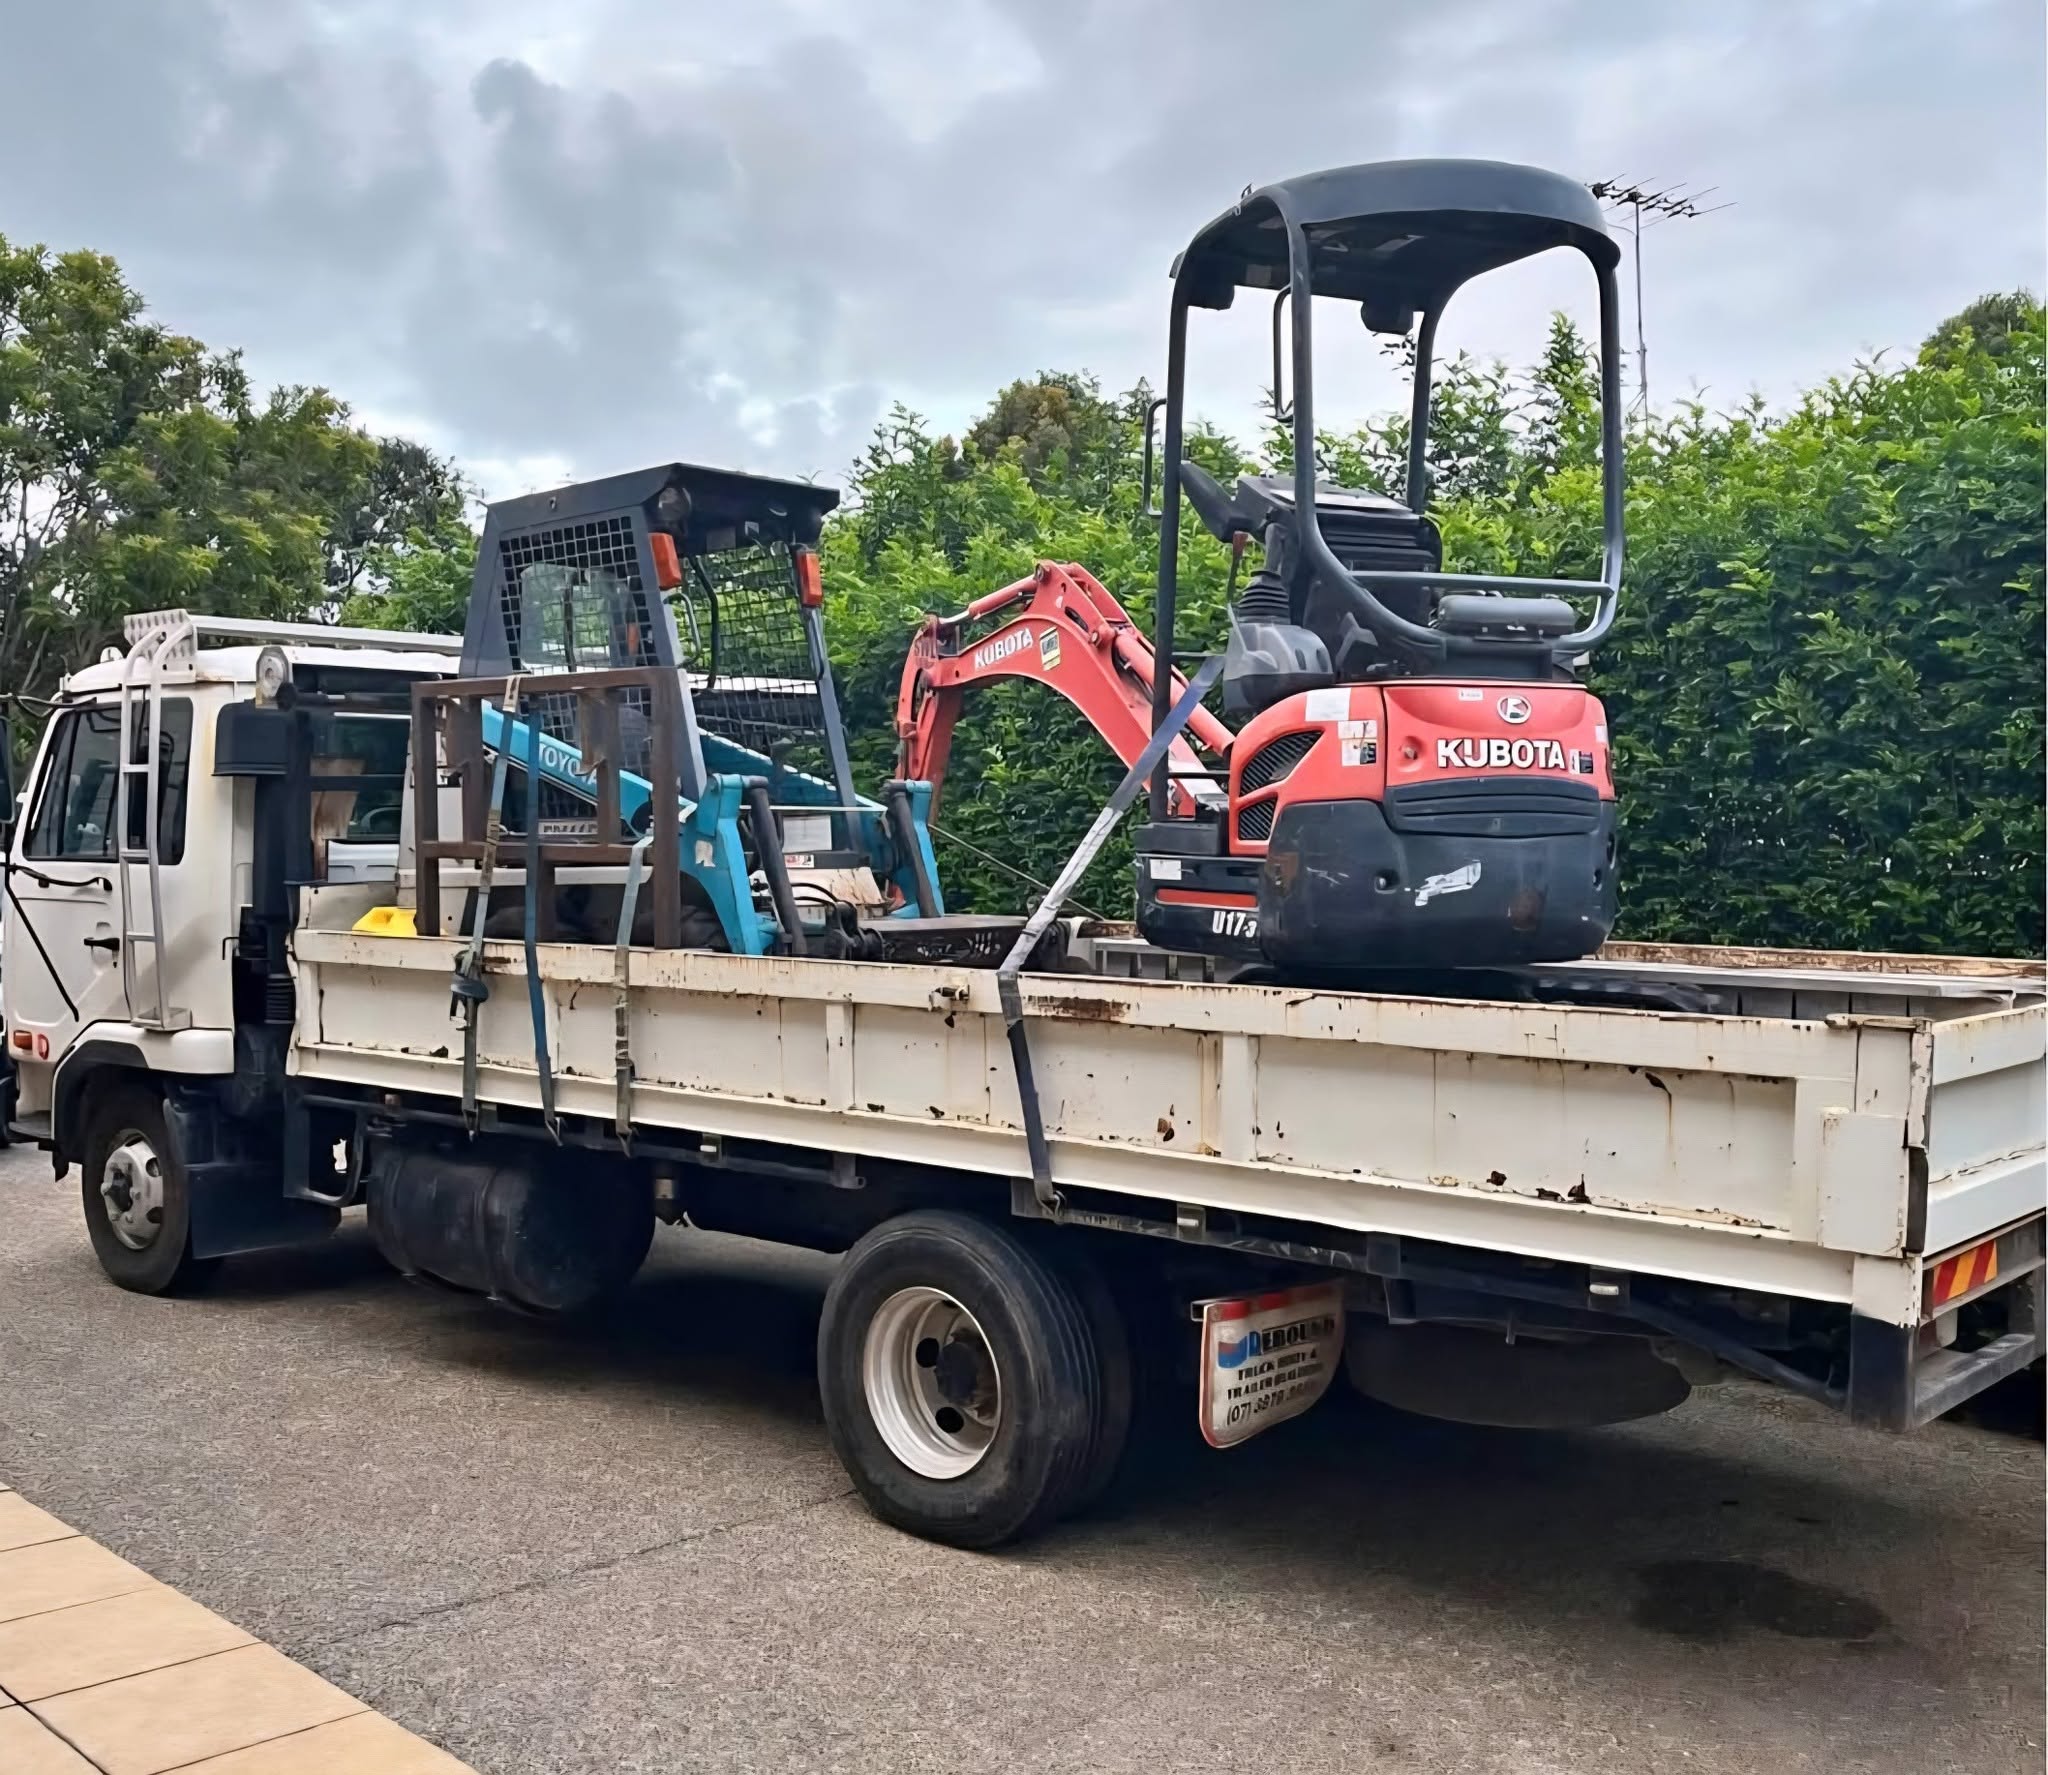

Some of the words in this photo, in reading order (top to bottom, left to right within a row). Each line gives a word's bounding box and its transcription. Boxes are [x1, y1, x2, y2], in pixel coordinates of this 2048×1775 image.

[975, 627, 1033, 667] KUBOTA
[540, 743, 597, 785] TOYOA
[1437, 738, 1566, 769] KUBOTA
